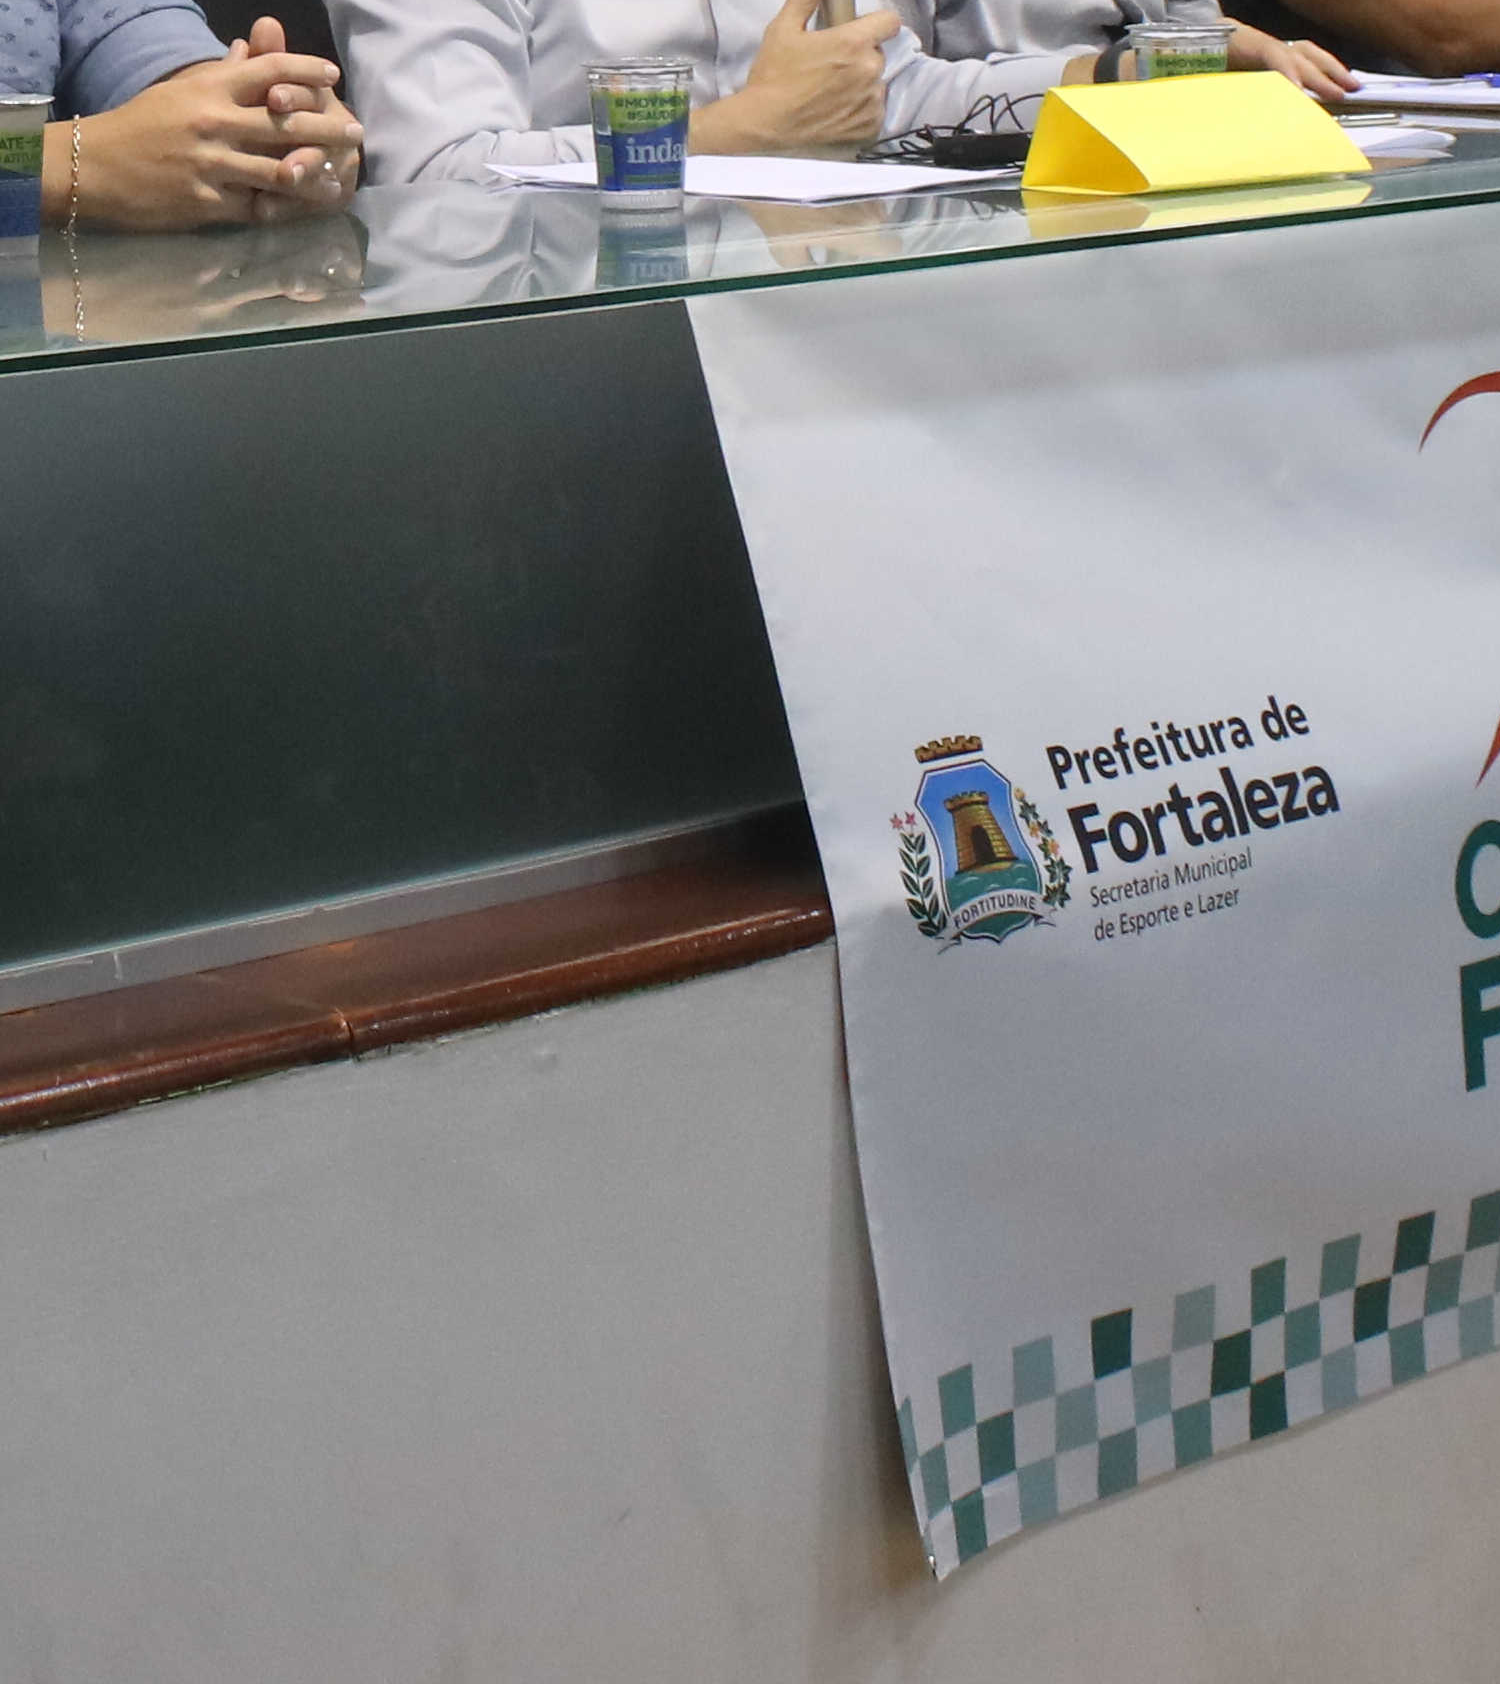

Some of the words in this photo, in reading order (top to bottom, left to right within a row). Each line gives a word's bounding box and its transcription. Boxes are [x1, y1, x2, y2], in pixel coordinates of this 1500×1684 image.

[1046, 715, 1253, 791] Prefeitura
[1260, 694, 1311, 743] de
[1067, 764, 1341, 874] Fortaleza
[1089, 869, 1171, 909] Secretaria
[1173, 845, 1254, 887] Municipal
[953, 893, 1037, 929] FORTITUDINE
[1093, 917, 1115, 942] de
[1119, 902, 1180, 940] Esporte
[1184, 900, 1194, 918] e
[1199, 887, 1240, 916] Lazer
